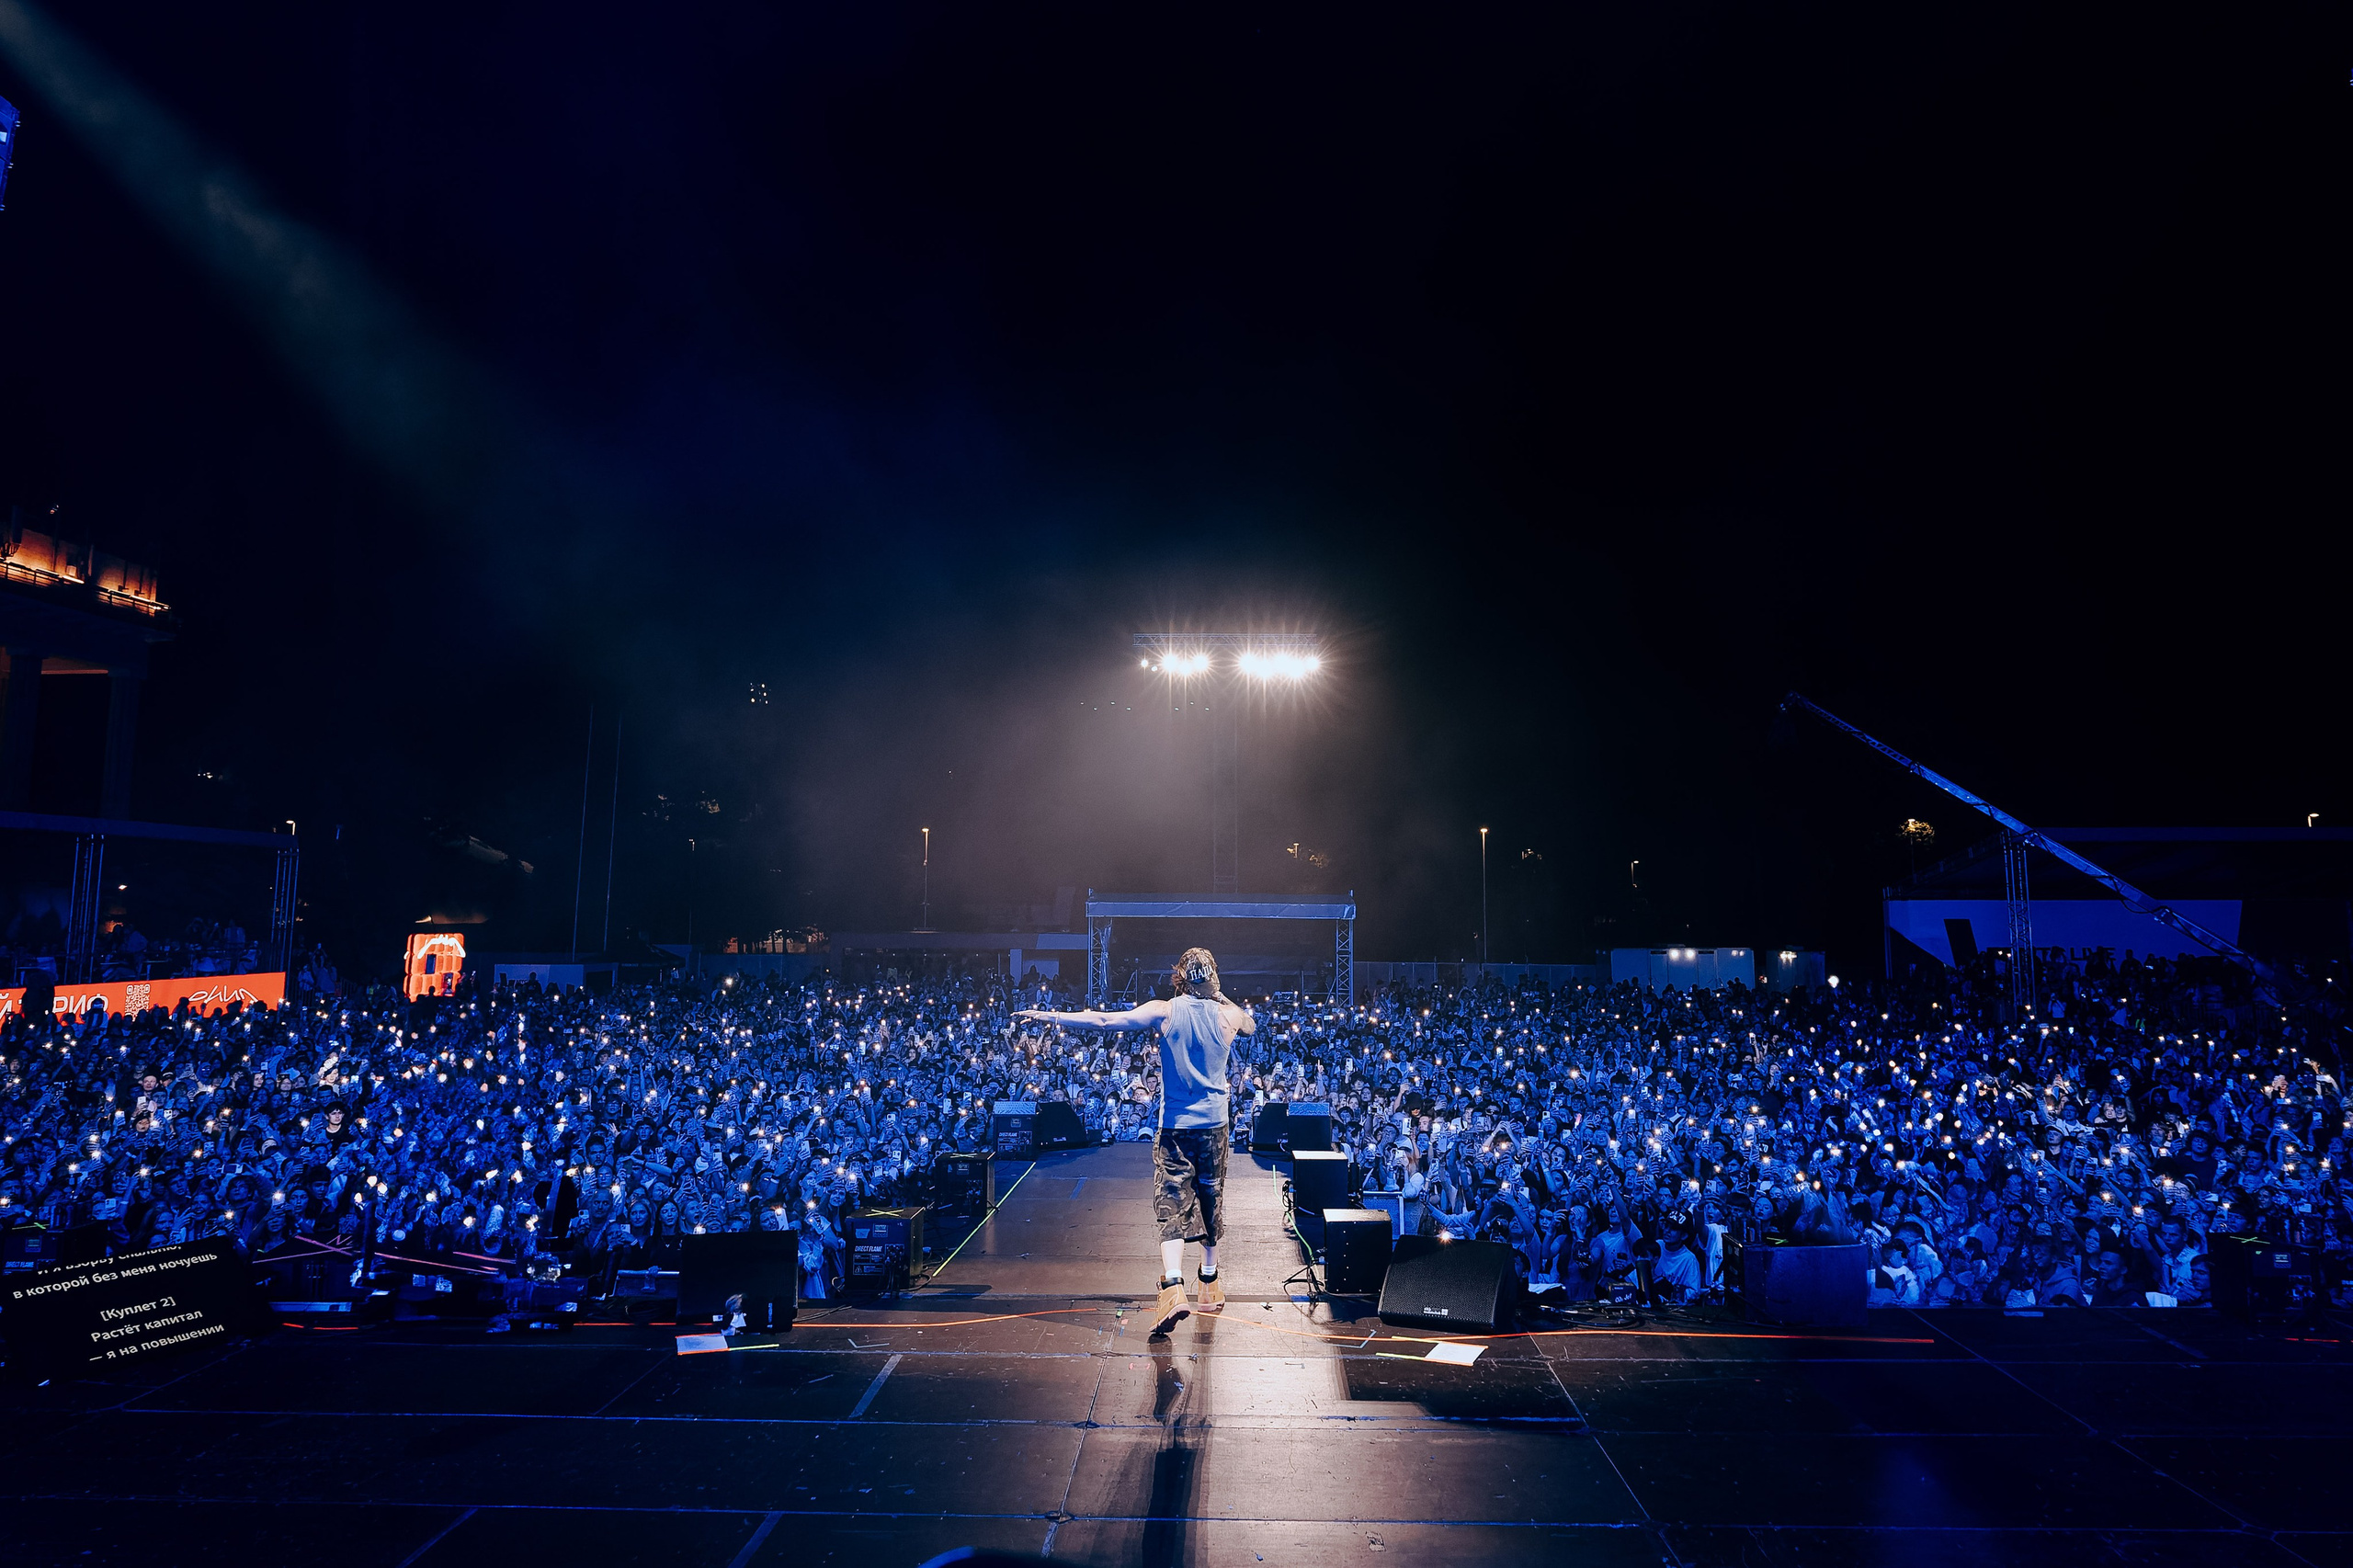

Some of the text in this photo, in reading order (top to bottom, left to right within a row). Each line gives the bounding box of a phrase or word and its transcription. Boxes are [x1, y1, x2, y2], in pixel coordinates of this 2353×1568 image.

[1189, 964, 1214, 981] ПАПА
[13, 1290, 24, 1300] в
[26, 1275, 90, 1297] которой
[92, 1272, 119, 1283] без
[120, 1265, 157, 1278] меня
[159, 1253, 218, 1270] ночуешь
[99, 1296, 176, 1322] [Куплет 2]
[90, 1311, 203, 1343] Растёт капитал
[106, 1350, 117, 1359] я
[119, 1346, 139, 1356] на
[141, 1324, 225, 1351] повышении
